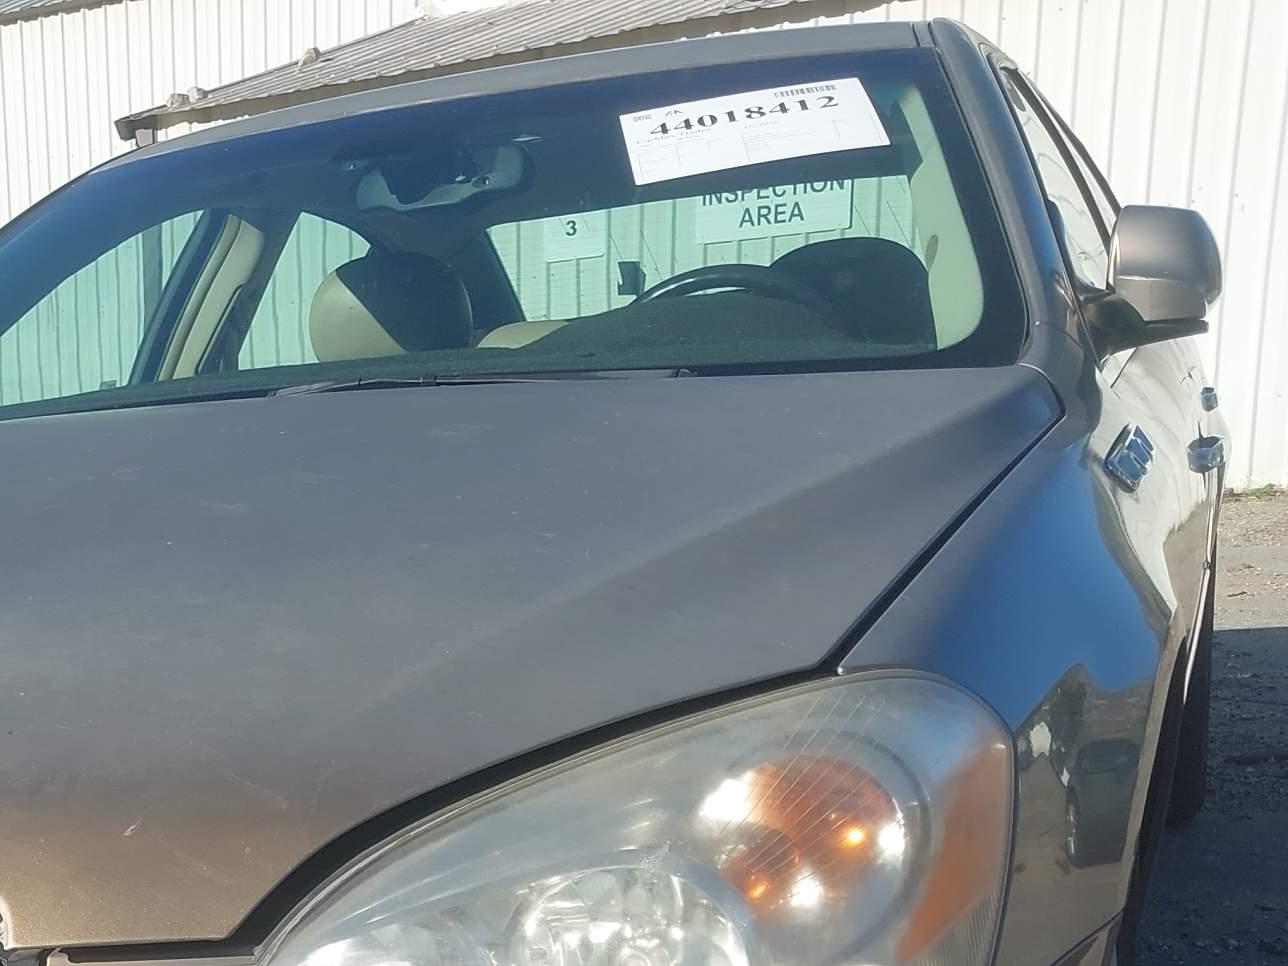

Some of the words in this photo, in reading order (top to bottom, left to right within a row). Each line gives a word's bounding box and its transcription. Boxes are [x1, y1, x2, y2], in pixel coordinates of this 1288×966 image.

[650, 95, 839, 135] 44018412
[565, 220, 577, 236] 3
[739, 201, 805, 228] AREA
